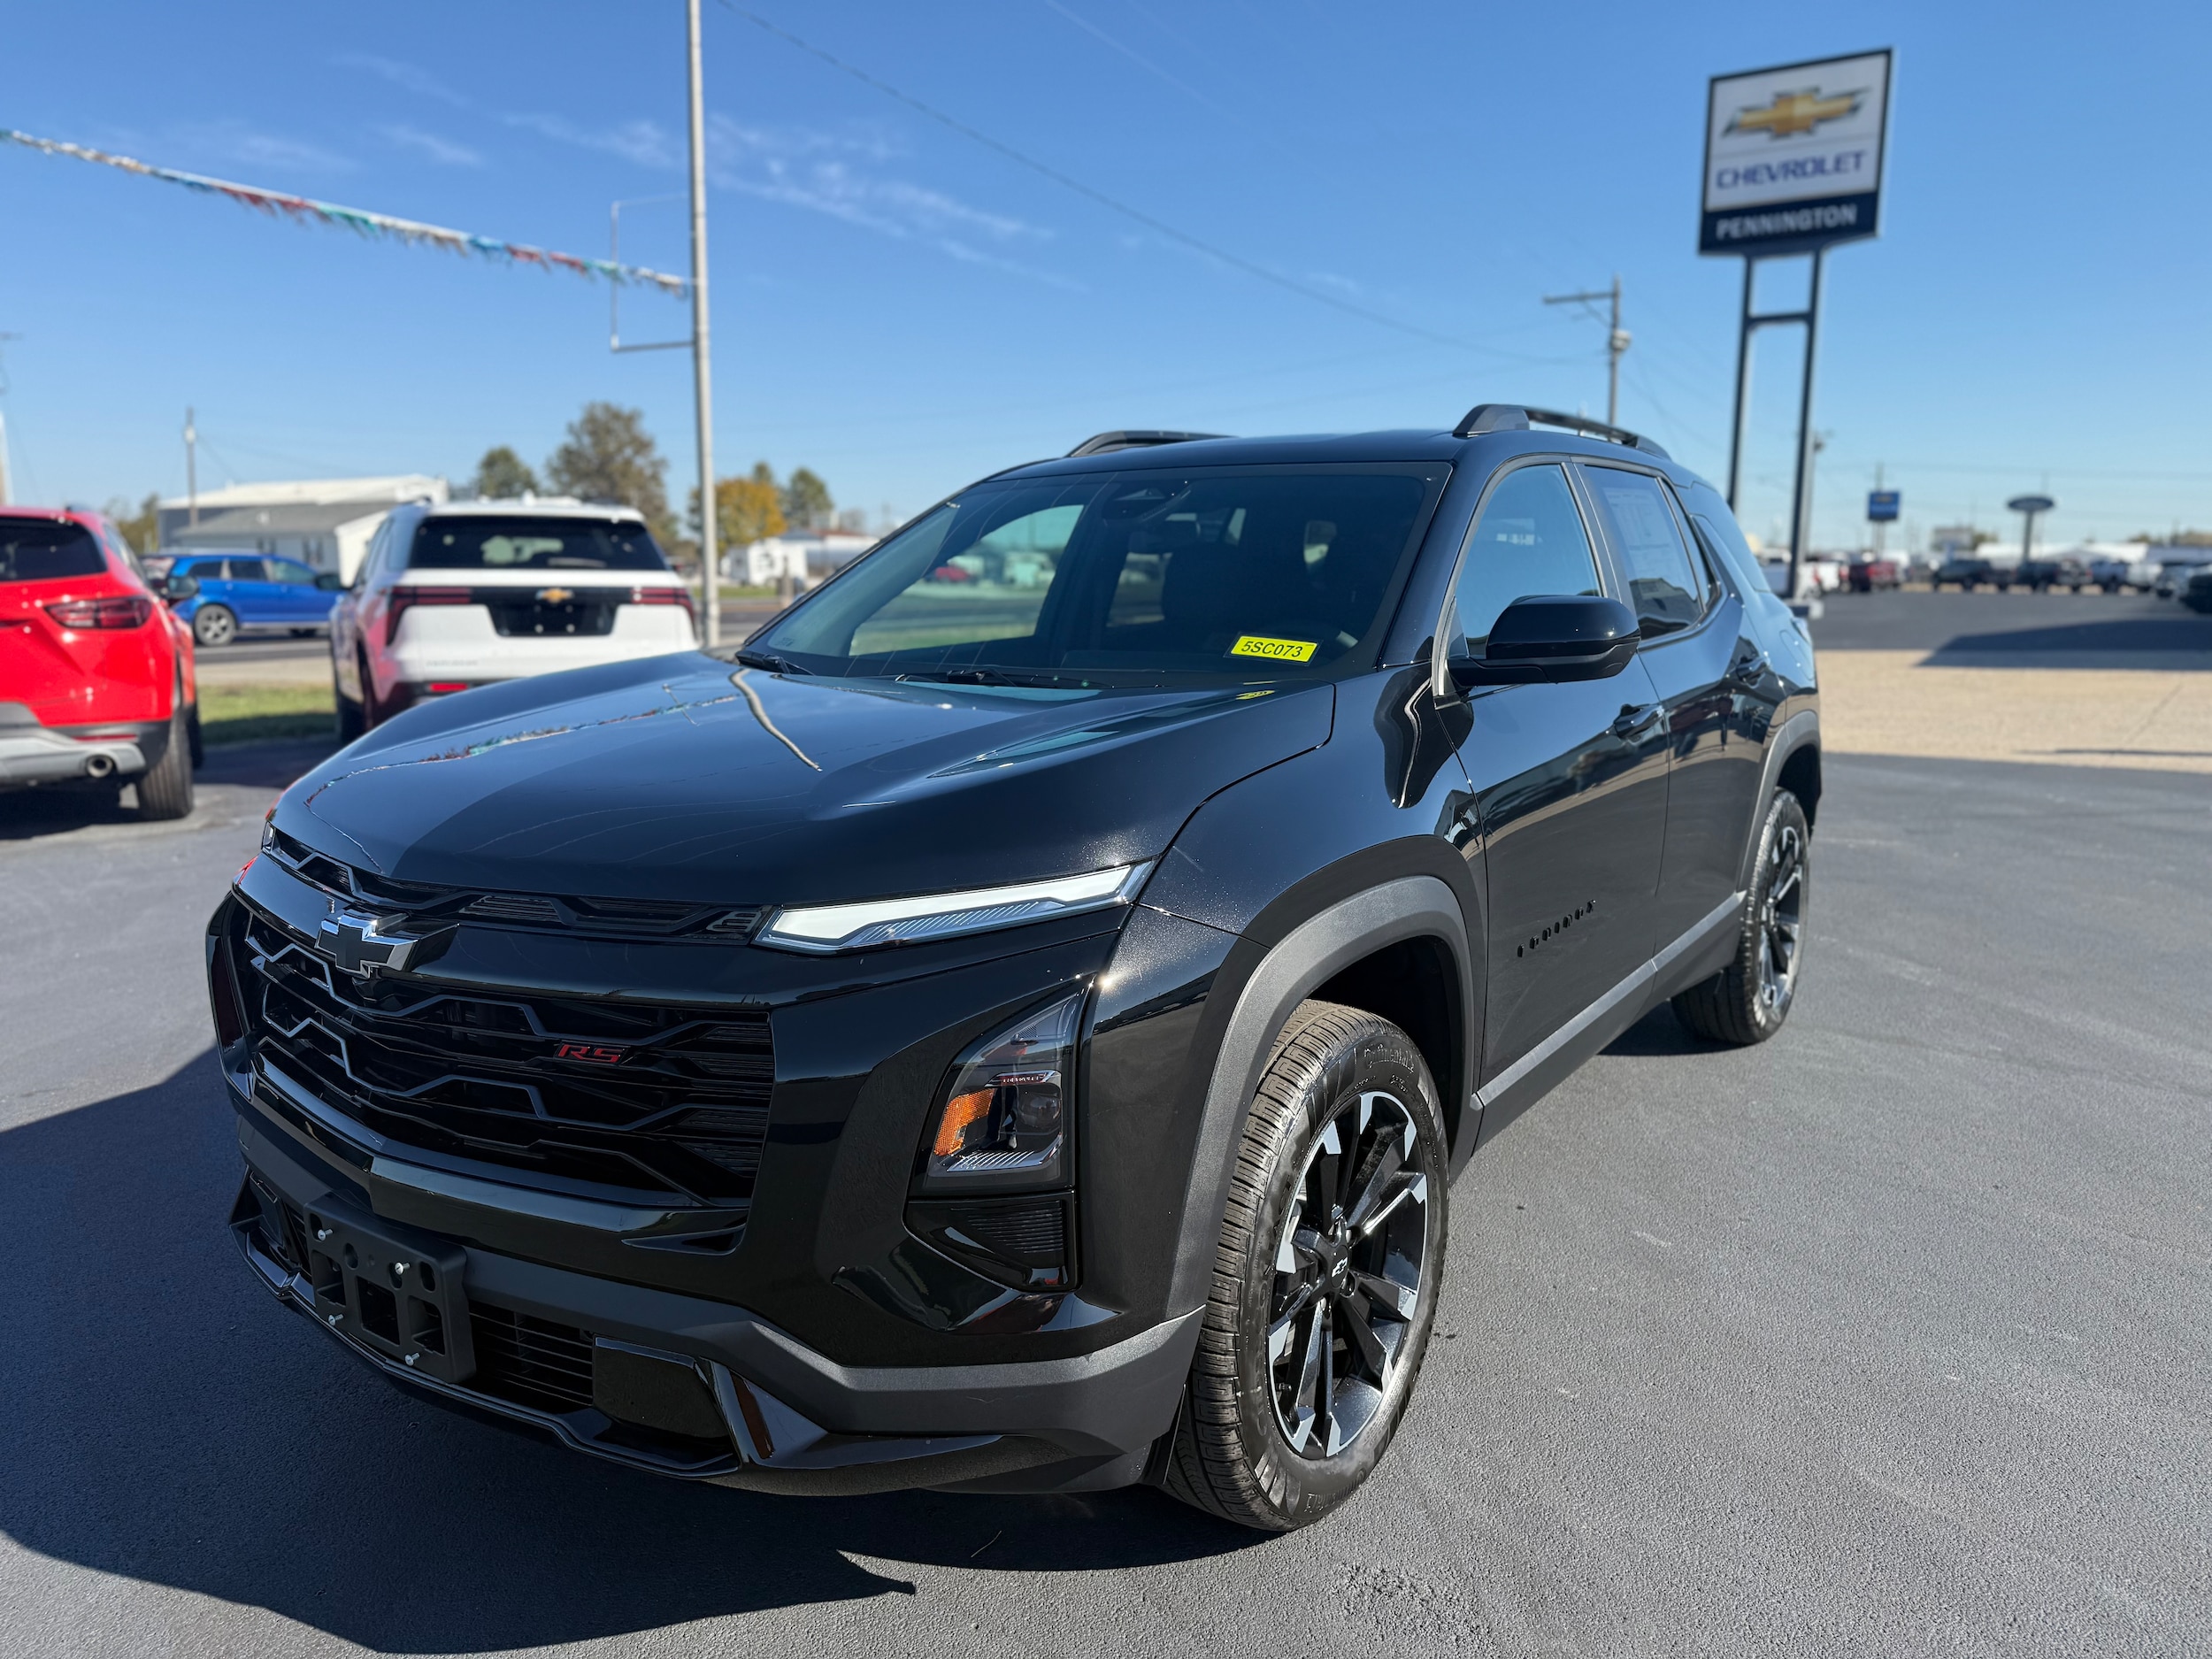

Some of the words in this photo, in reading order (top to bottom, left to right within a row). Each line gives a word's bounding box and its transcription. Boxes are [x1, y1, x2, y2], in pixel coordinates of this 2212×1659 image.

[1717, 150, 1866, 189] CHEVROLET
[1715, 204, 1858, 241] PENNINGTON
[1240, 641, 1304, 658] 5SC073
[557, 1044, 625, 1064] RS
